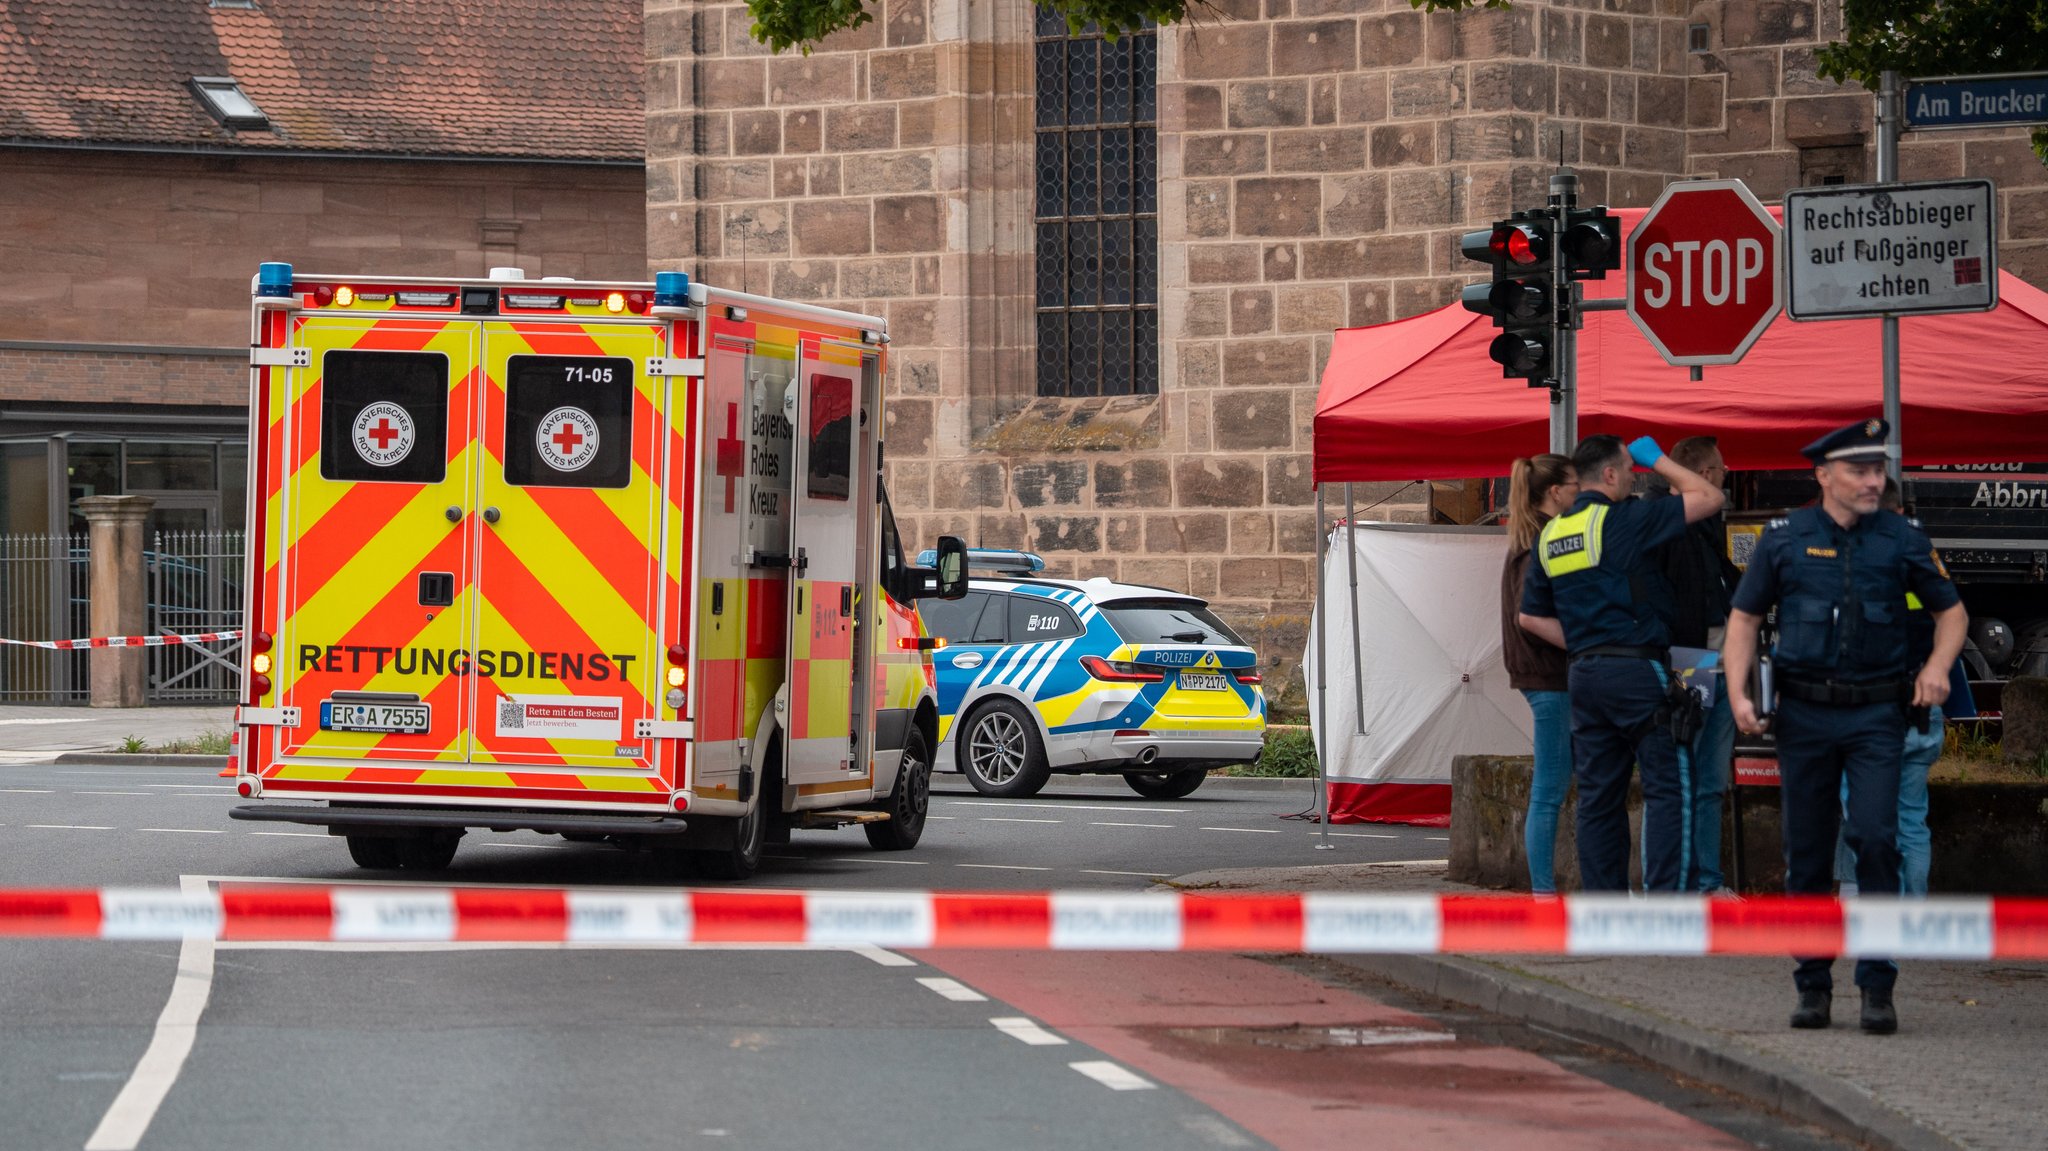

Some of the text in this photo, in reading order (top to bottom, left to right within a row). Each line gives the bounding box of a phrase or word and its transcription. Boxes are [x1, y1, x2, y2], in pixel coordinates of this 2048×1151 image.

[1916, 88, 2046, 118] Am Brucker
[1804, 201, 1976, 231] Rechtsabbieger
[1811, 241, 1845, 265] auf
[1854, 236, 1969, 267] Fußgänger
[1644, 238, 1763, 308] STOP
[565, 367, 613, 383] 71-05
[359, 406, 409, 432] BAYERISCHES
[542, 412, 593, 437] BAYERISCHES
[358, 436, 409, 461] ROTES KREUZ
[542, 441, 593, 466] ROTES KREUZ
[751, 444, 779, 477] Rotes
[750, 483, 778, 516] Kreuz
[1547, 535, 1583, 556] POLIZEI
[1040, 616, 1059, 630] 110
[299, 644, 636, 682] RETTUNGSDIENST
[1155, 652, 1192, 663] POLIZEI
[1181, 675, 1226, 689] N PP 2170
[332, 707, 425, 727] ER A 7555
[529, 707, 617, 718] Rette mit den Besten!
